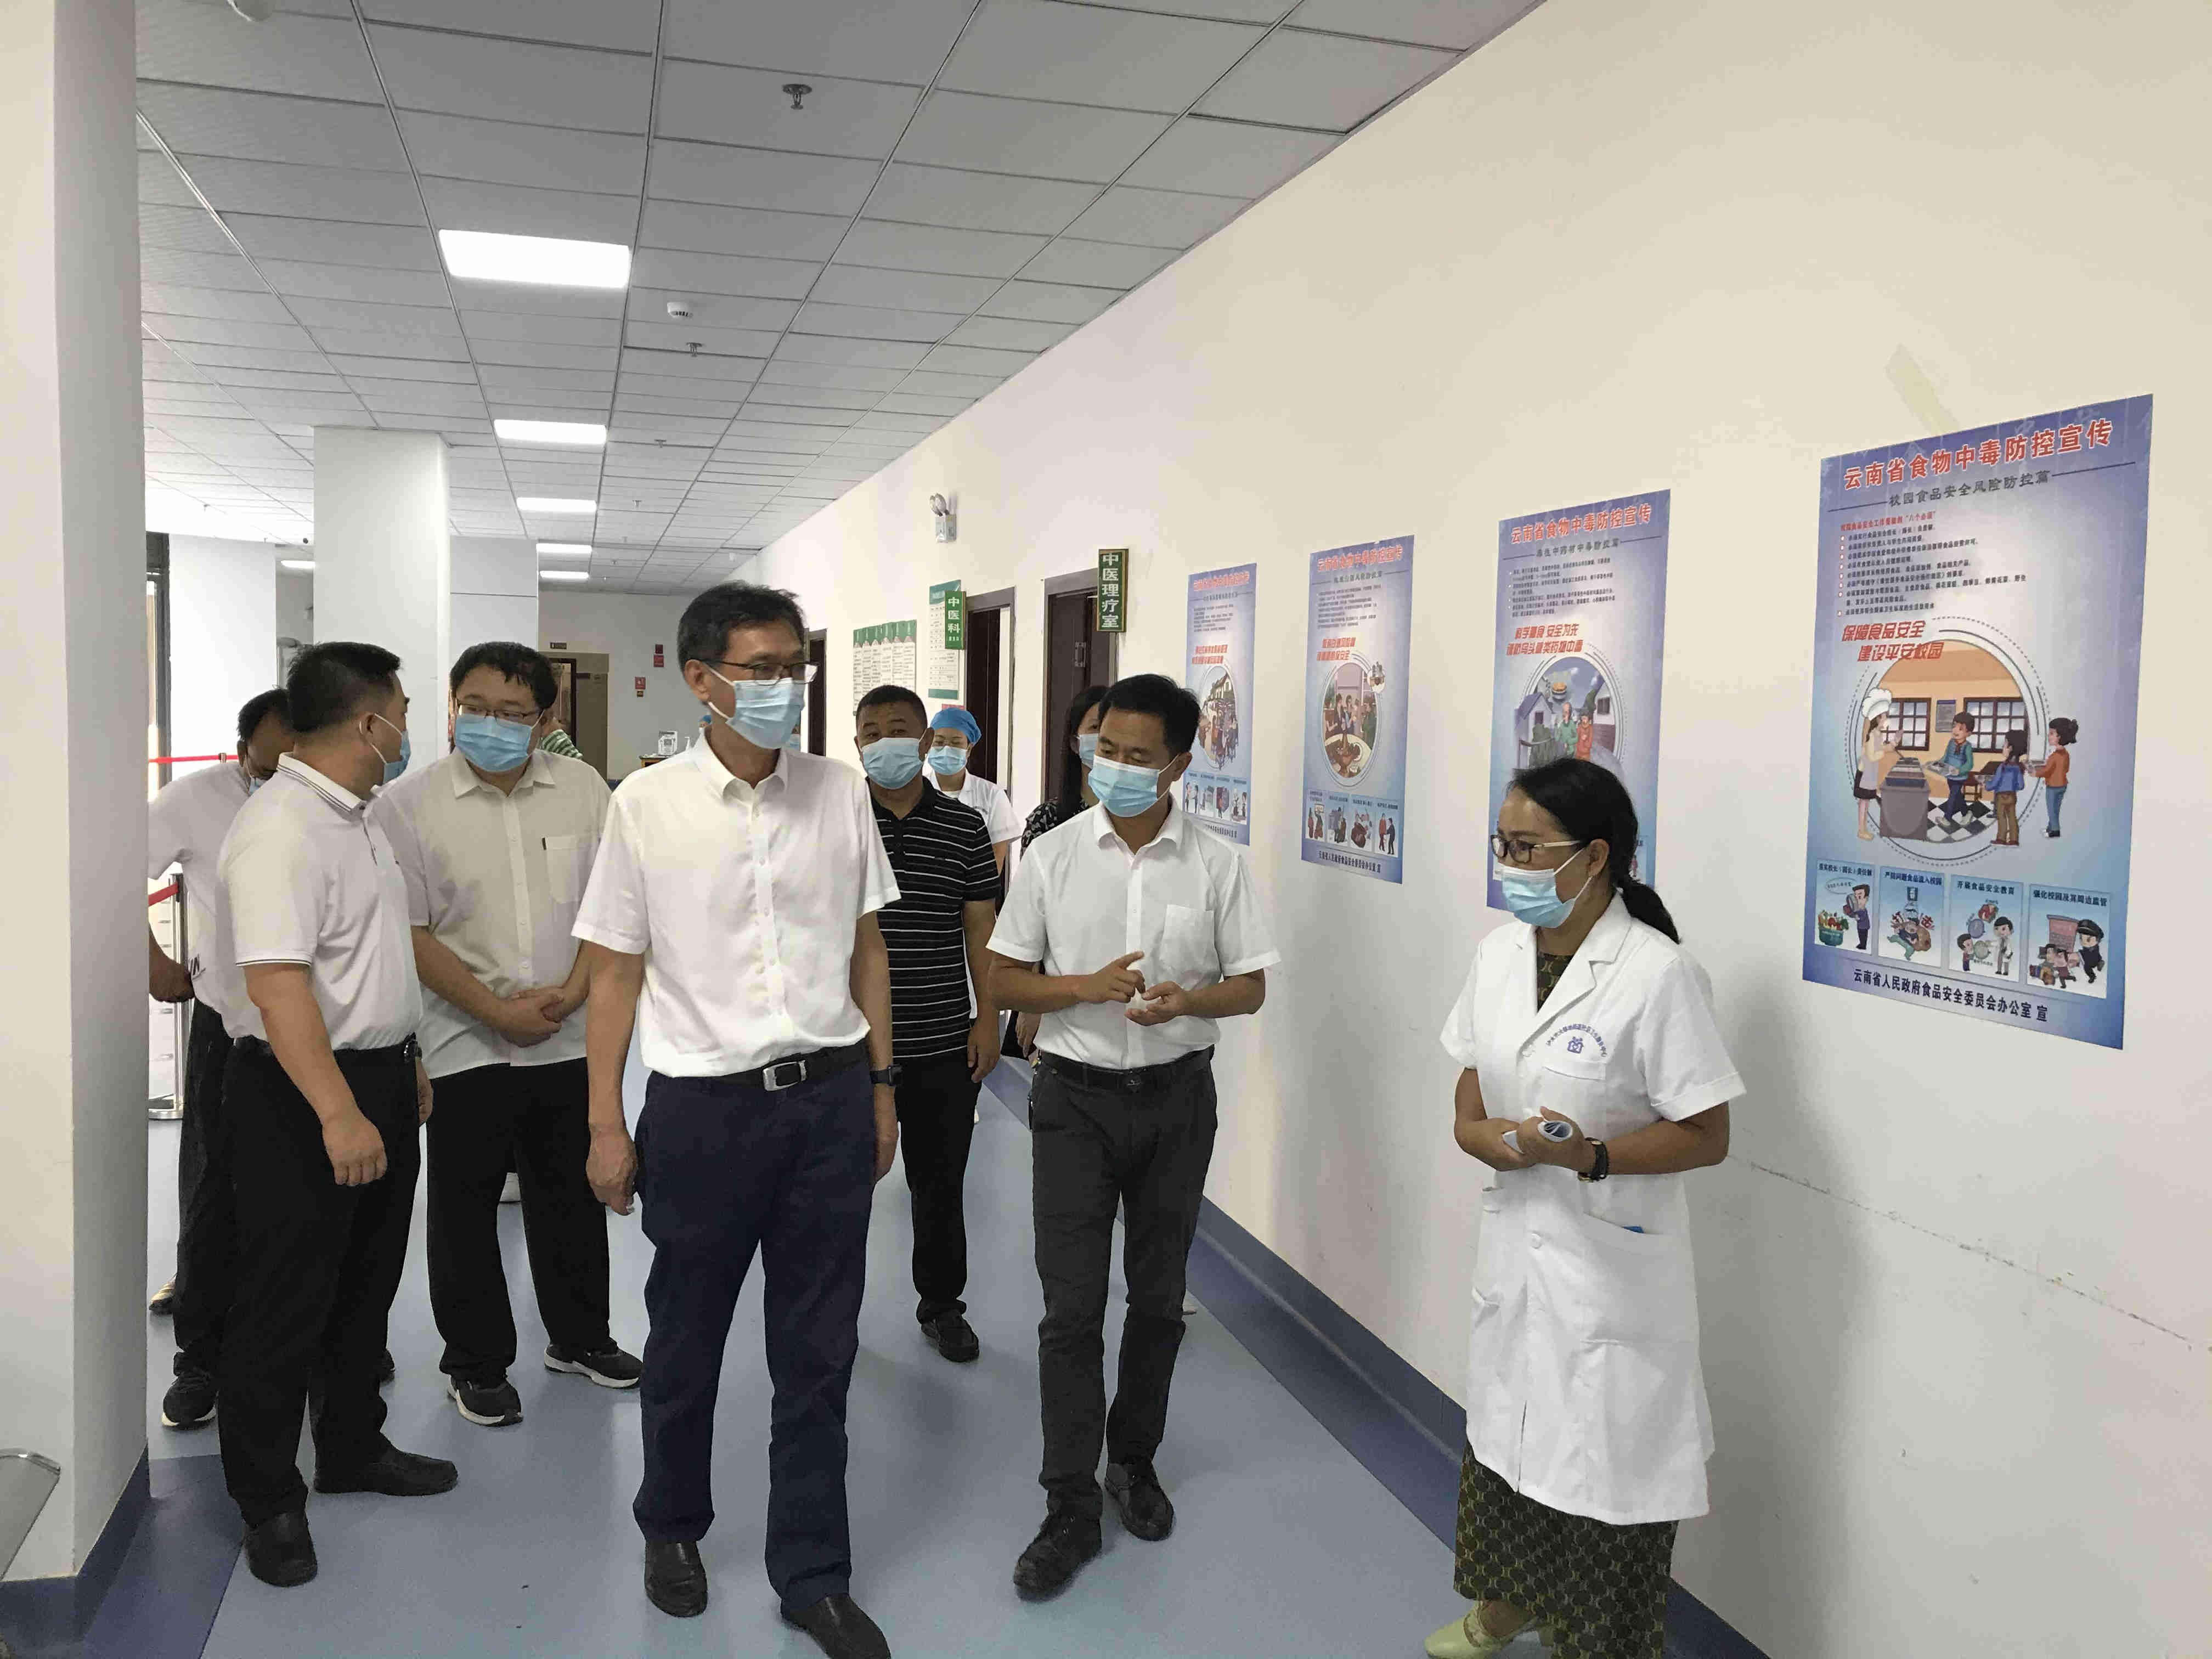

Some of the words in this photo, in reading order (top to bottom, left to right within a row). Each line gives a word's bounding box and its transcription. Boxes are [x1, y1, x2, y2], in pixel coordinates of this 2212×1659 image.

[1843, 418, 2113, 490] 云南省食物中毒防控宣传
[1888, 470, 2051, 507] 校园食品安全风险防控篇
[1510, 503, 1652, 544] 云南省食物中毒防控宣传
[1102, 552, 1119, 628] 中医理疗室
[948, 596, 961, 634] 中医科
[1842, 620, 1926, 641] 保障食品安全
[1858, 642, 1945, 662] 建设平安校园
[1957, 881, 2015, 895] 开展食品安全教育
[2033, 889, 2107, 907] 强化校园及其周边监管
[1853, 968, 2032, 1019] 云南省人民政府食品安全委员会办公室
[2036, 1005, 2049, 1022] 宣
